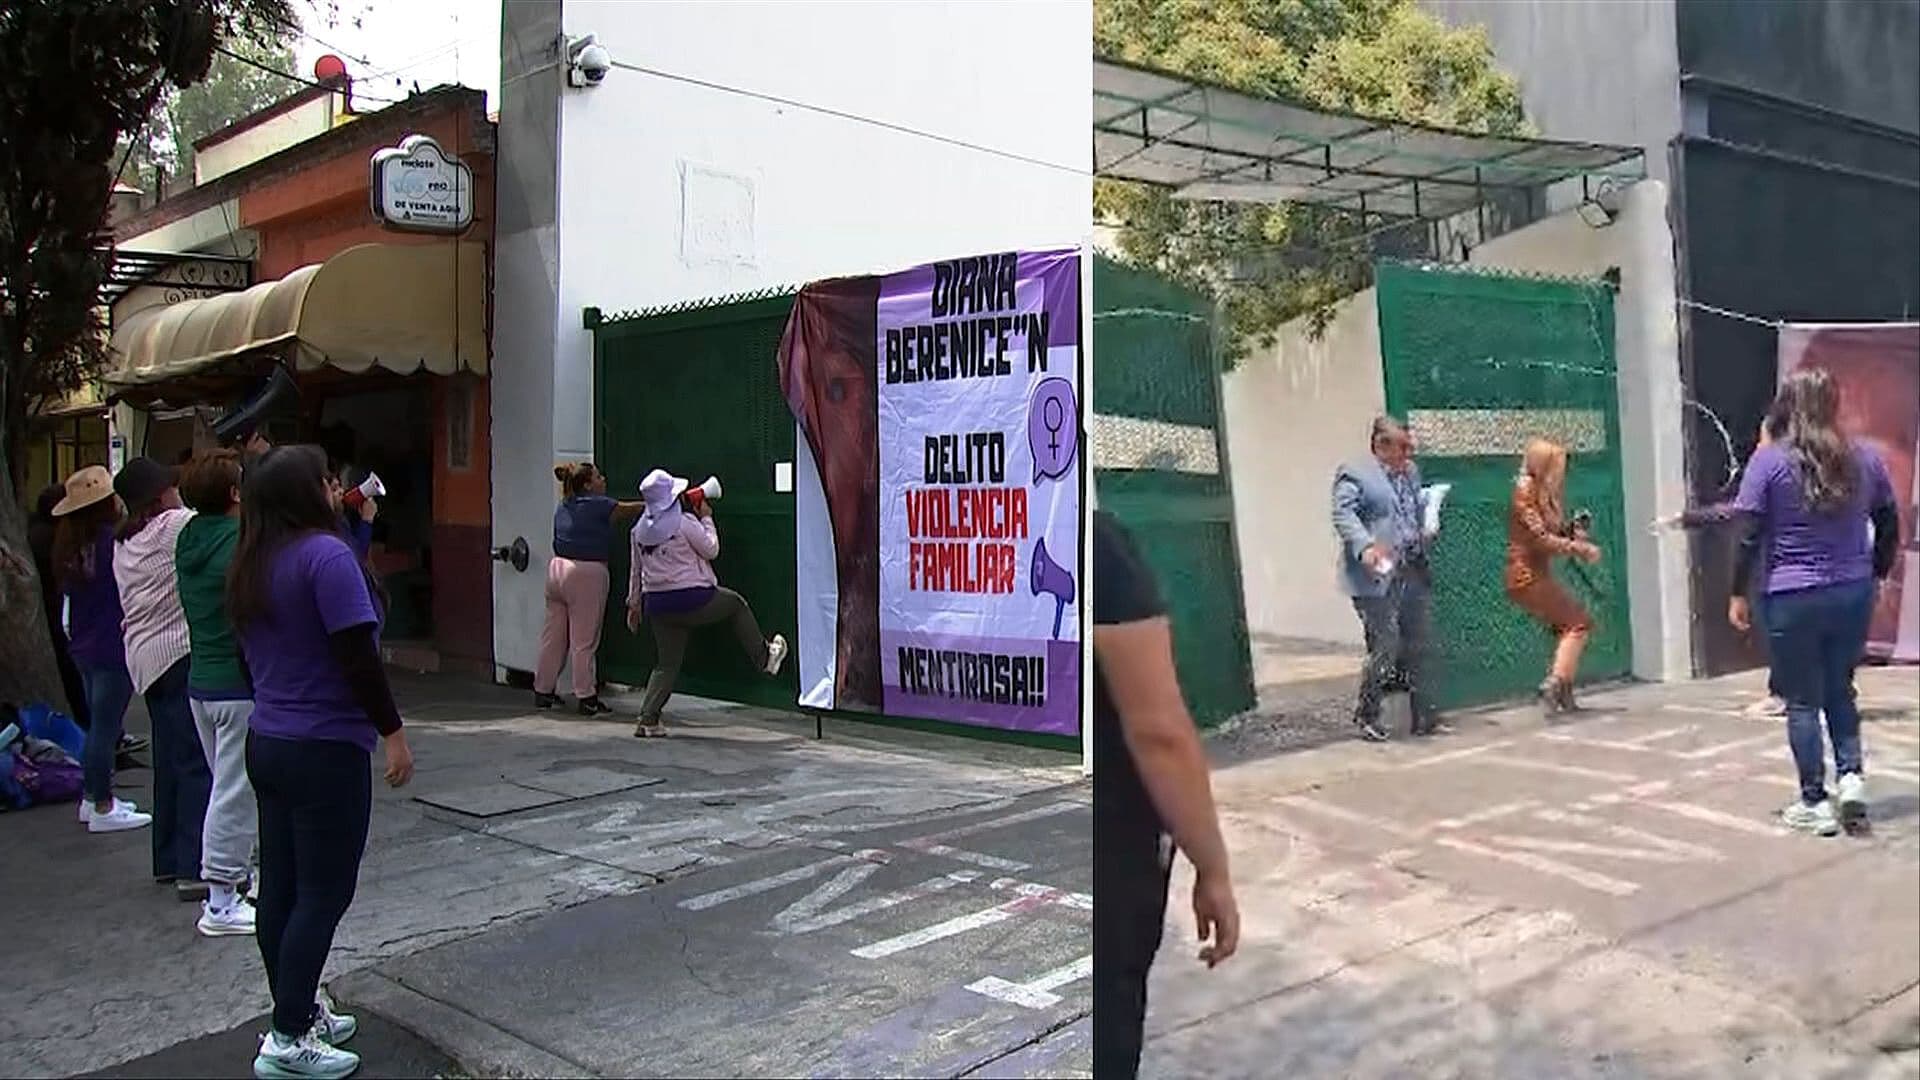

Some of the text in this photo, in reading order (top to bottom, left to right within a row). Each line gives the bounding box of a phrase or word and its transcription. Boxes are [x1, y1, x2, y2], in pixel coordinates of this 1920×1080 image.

[394, 201, 407, 209] DE
[409, 202, 438, 212] VENTA
[931, 252, 1017, 317] DIANA
[924, 432, 1005, 484] DELITO
[905, 487, 1029, 539] VIOLENCIA
[909, 543, 1016, 594] FAMILIAR
[898, 647, 1045, 707] MENTIROSA!!
